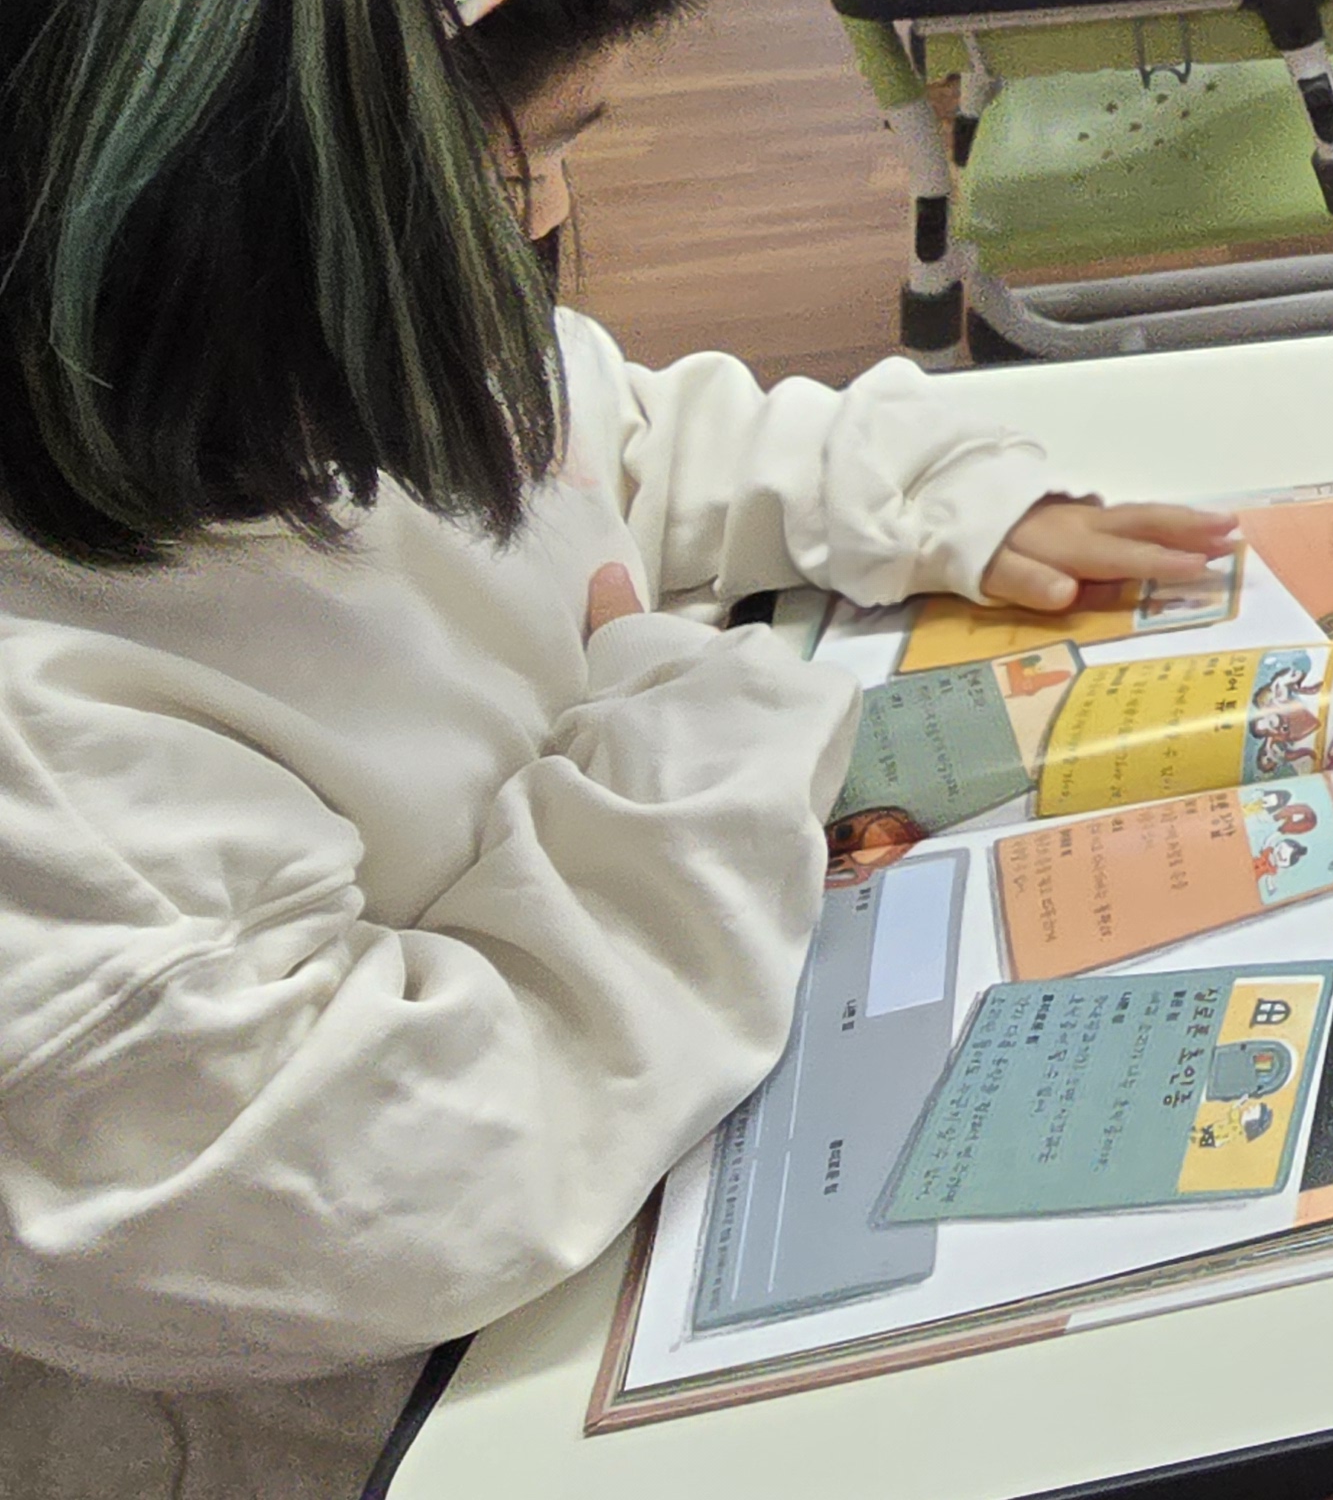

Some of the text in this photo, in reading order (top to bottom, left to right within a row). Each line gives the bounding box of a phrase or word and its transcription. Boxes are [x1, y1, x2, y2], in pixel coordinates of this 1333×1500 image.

[1118, 991, 1132, 1010] 나쁜
[1163, 987, 1218, 1108] 실로폰 초인종
